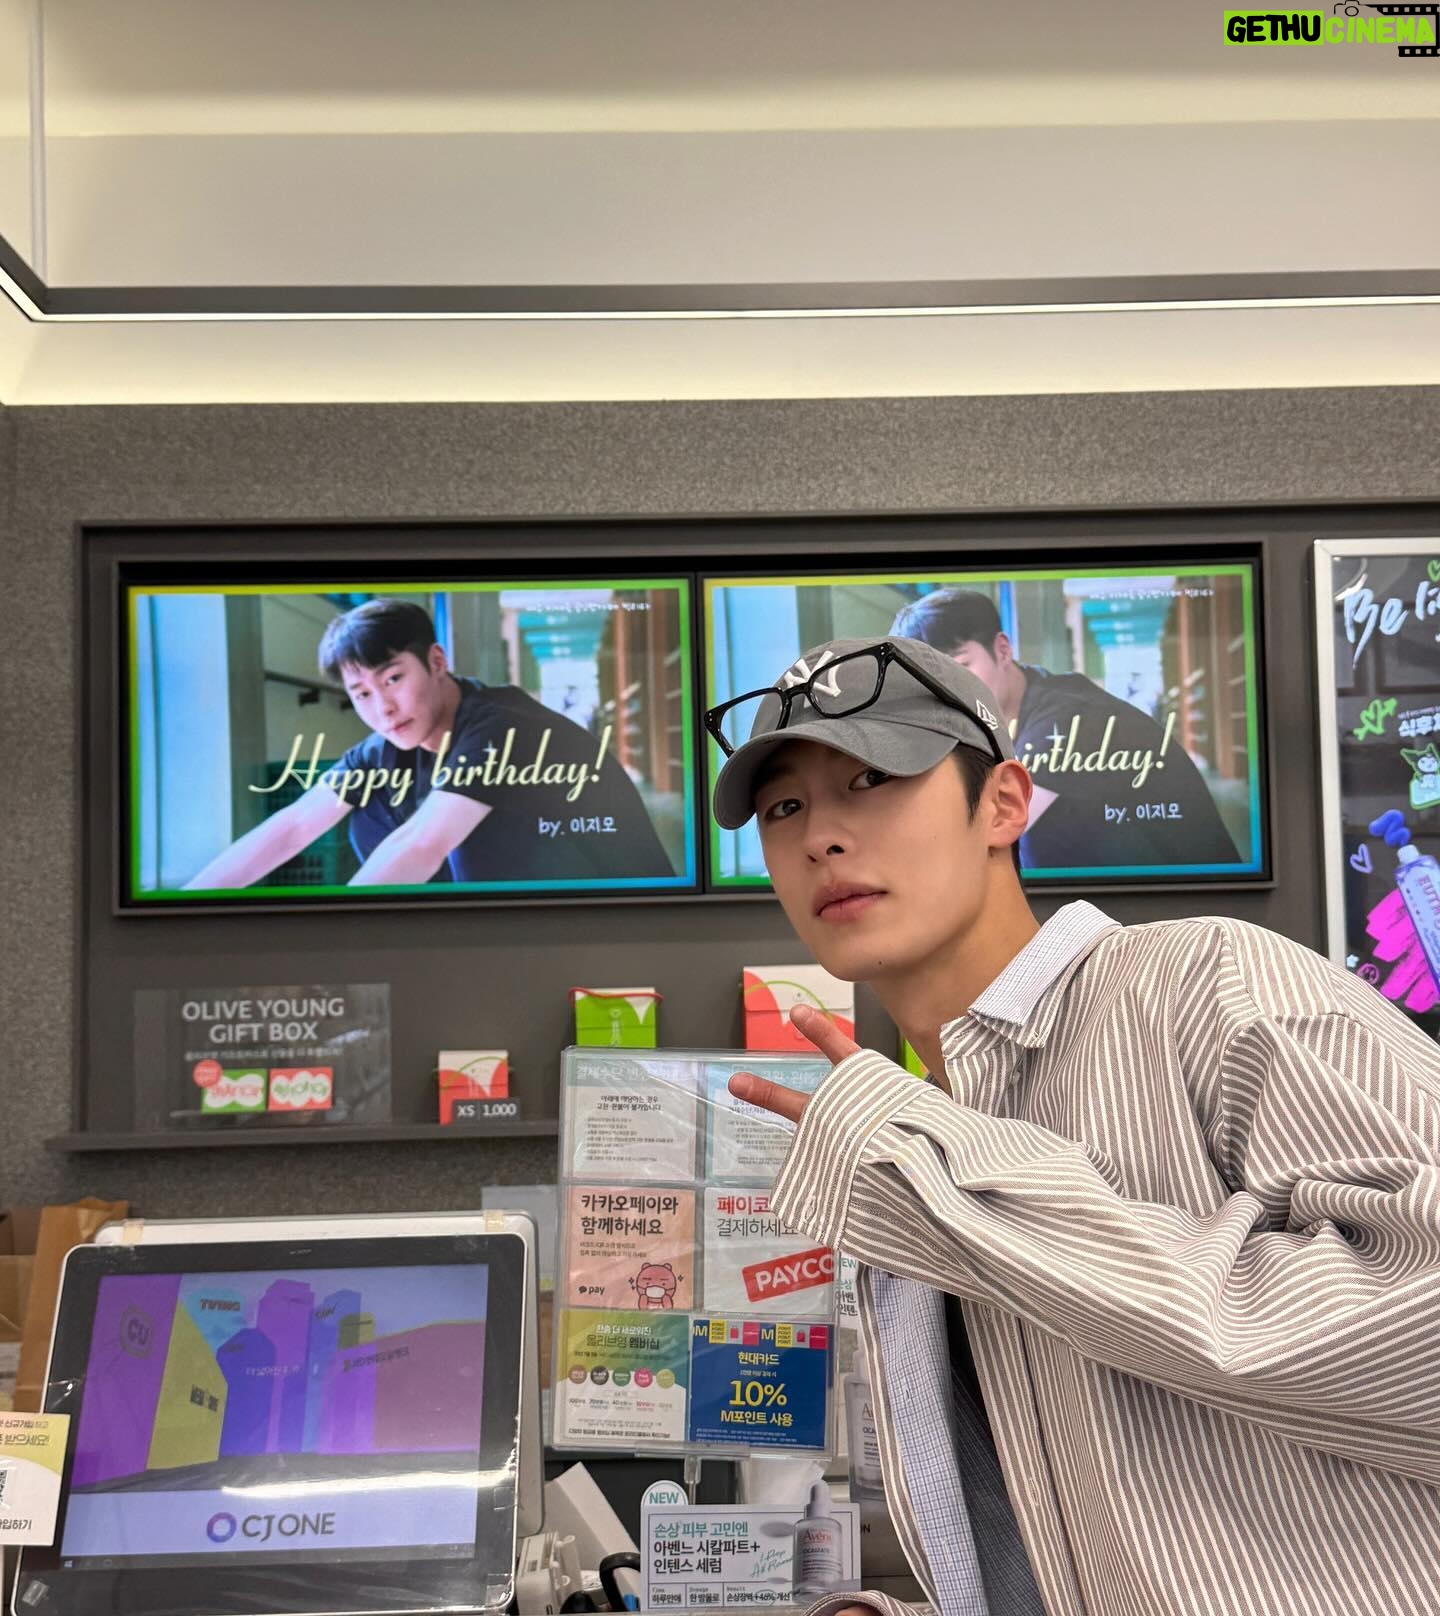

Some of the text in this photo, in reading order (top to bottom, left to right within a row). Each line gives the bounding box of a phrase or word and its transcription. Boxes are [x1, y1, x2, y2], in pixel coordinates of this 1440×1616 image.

[1007, 711, 1176, 789] irthday!
[248, 724, 612, 808] Happy birthday!
[1104, 801, 1183, 825] by. 이지오
[538, 815, 617, 838] by. 이지오
[182, 997, 345, 1021] OLIVE YOUNG
[209, 1021, 318, 1043] GIFT BOX
[458, 1104, 475, 1117] XS
[581, 1194, 679, 1215] 카카오페이와
[581, 1216, 664, 1236] 함께하세요
[716, 1217, 799, 1238] 결제하세요
[840, 1257, 857, 1268] EW
[755, 1254, 836, 1292] PAYCO
[588, 1286, 606, 1295] pay
[586, 1334, 660, 1351] 올리브영 멤버십
[738, 1351, 780, 1366] 현대카드
[729, 1380, 788, 1407] 10%
[721, 1410, 794, 1427] M포인트 사용
[650, 1491, 679, 1504] NEW
[242, 1512, 335, 1542] CJ ONE
[655, 1521, 749, 1538] 손상 피부 고민엔
[654, 1540, 761, 1556] 아벤느 시칼파트+
[654, 1558, 722, 1575] 인텐스 세럼
